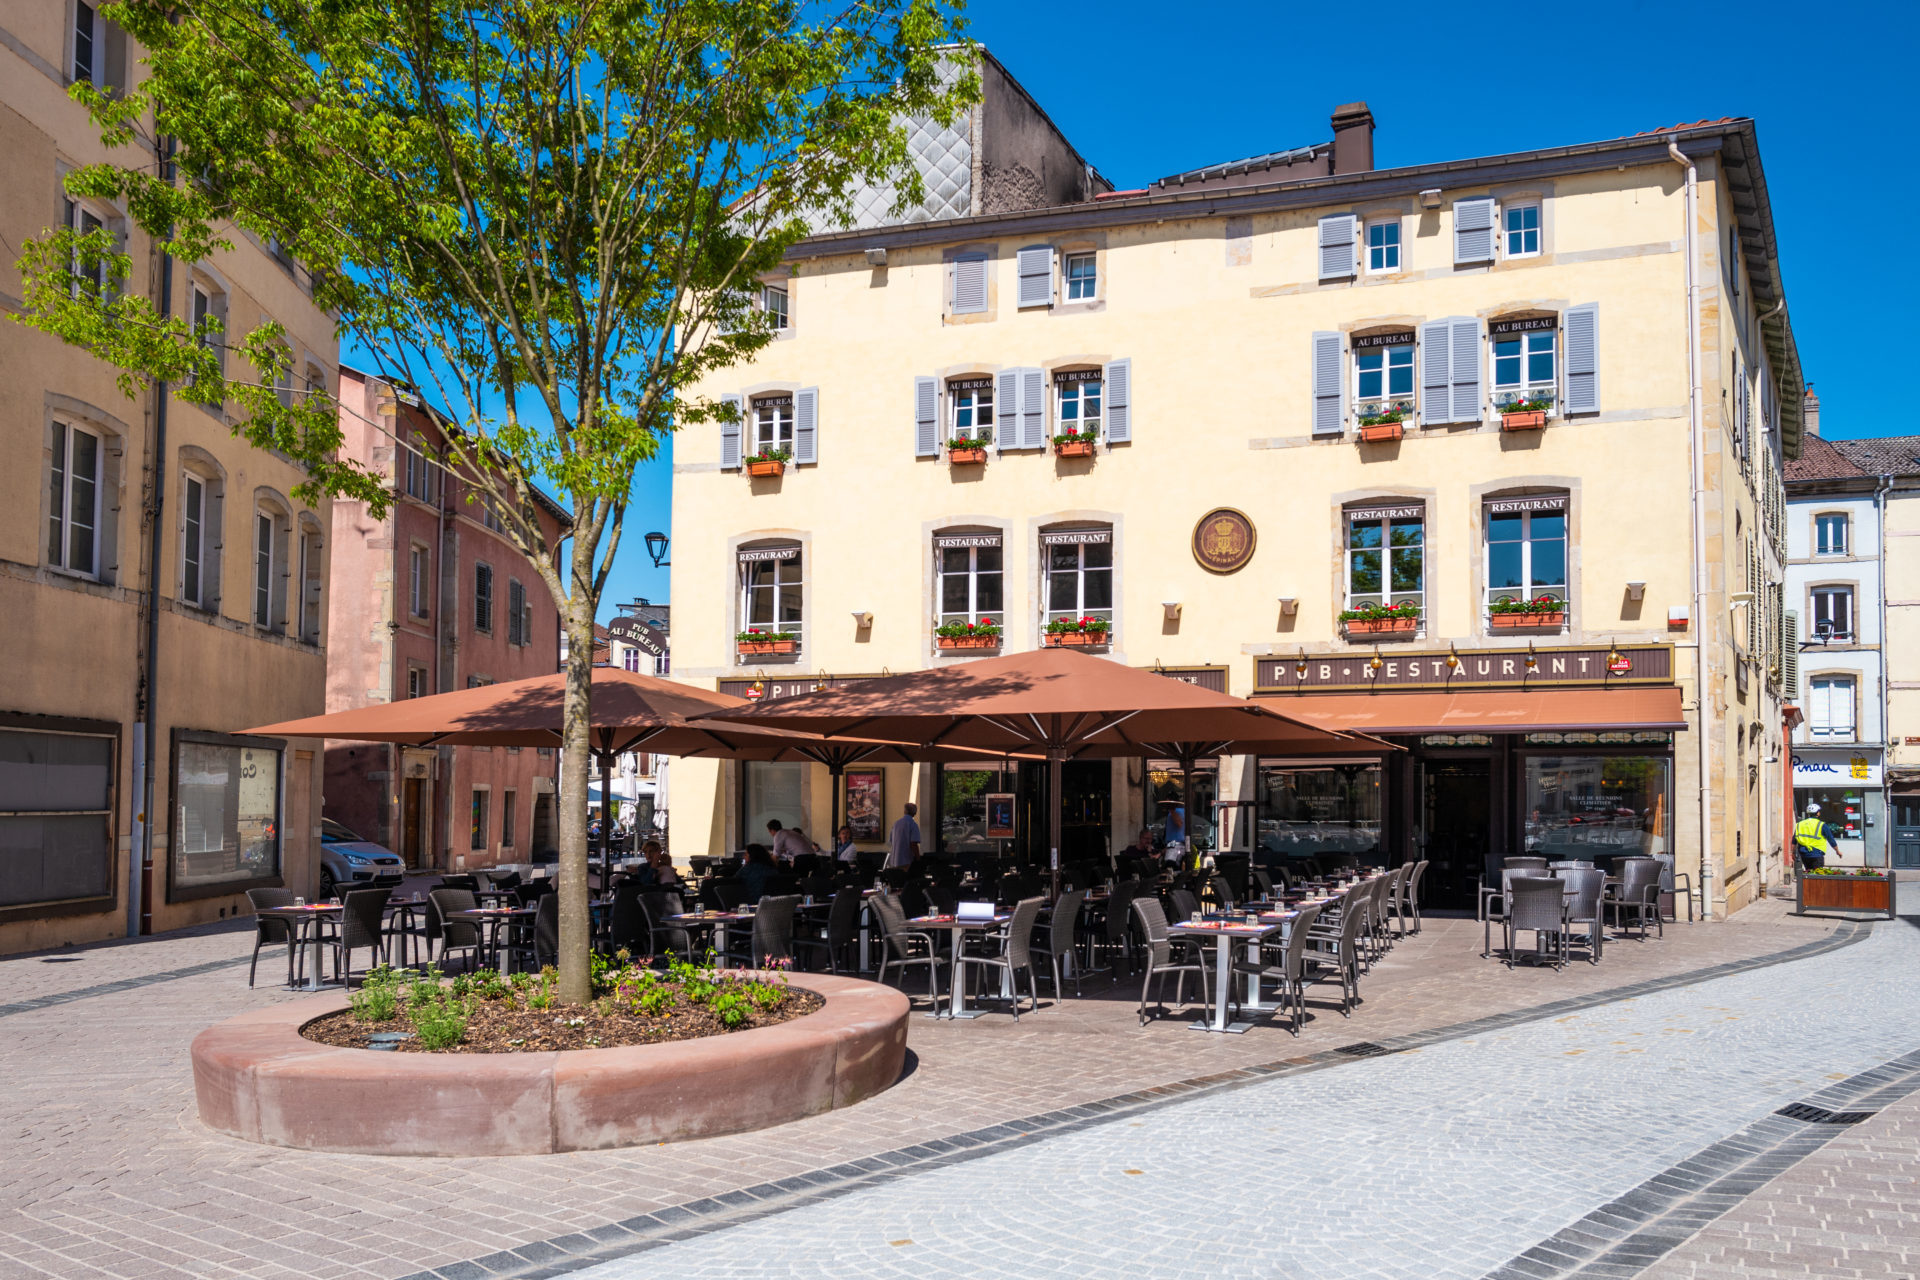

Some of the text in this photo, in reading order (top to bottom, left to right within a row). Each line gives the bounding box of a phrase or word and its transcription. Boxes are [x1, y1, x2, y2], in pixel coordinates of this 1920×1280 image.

[1495, 319, 1552, 332] AU BUREAU
[1358, 334, 1412, 346] AU BUREAU
[1055, 373, 1067, 382] AU
[949, 382, 961, 390] AU
[1491, 499, 1565, 512] RESTAURANT
[1350, 508, 1419, 520] RESTAURANT
[939, 538, 998, 547] RESTAURANT
[1045, 533, 1107, 544] RESTAURANT
[740, 550, 794, 561] RESTAURANT
[632, 623, 650, 635] PUB
[610, 627, 661, 655] AU BUREAU
[1274, 657, 1590, 681] PUB RESTAURANT
